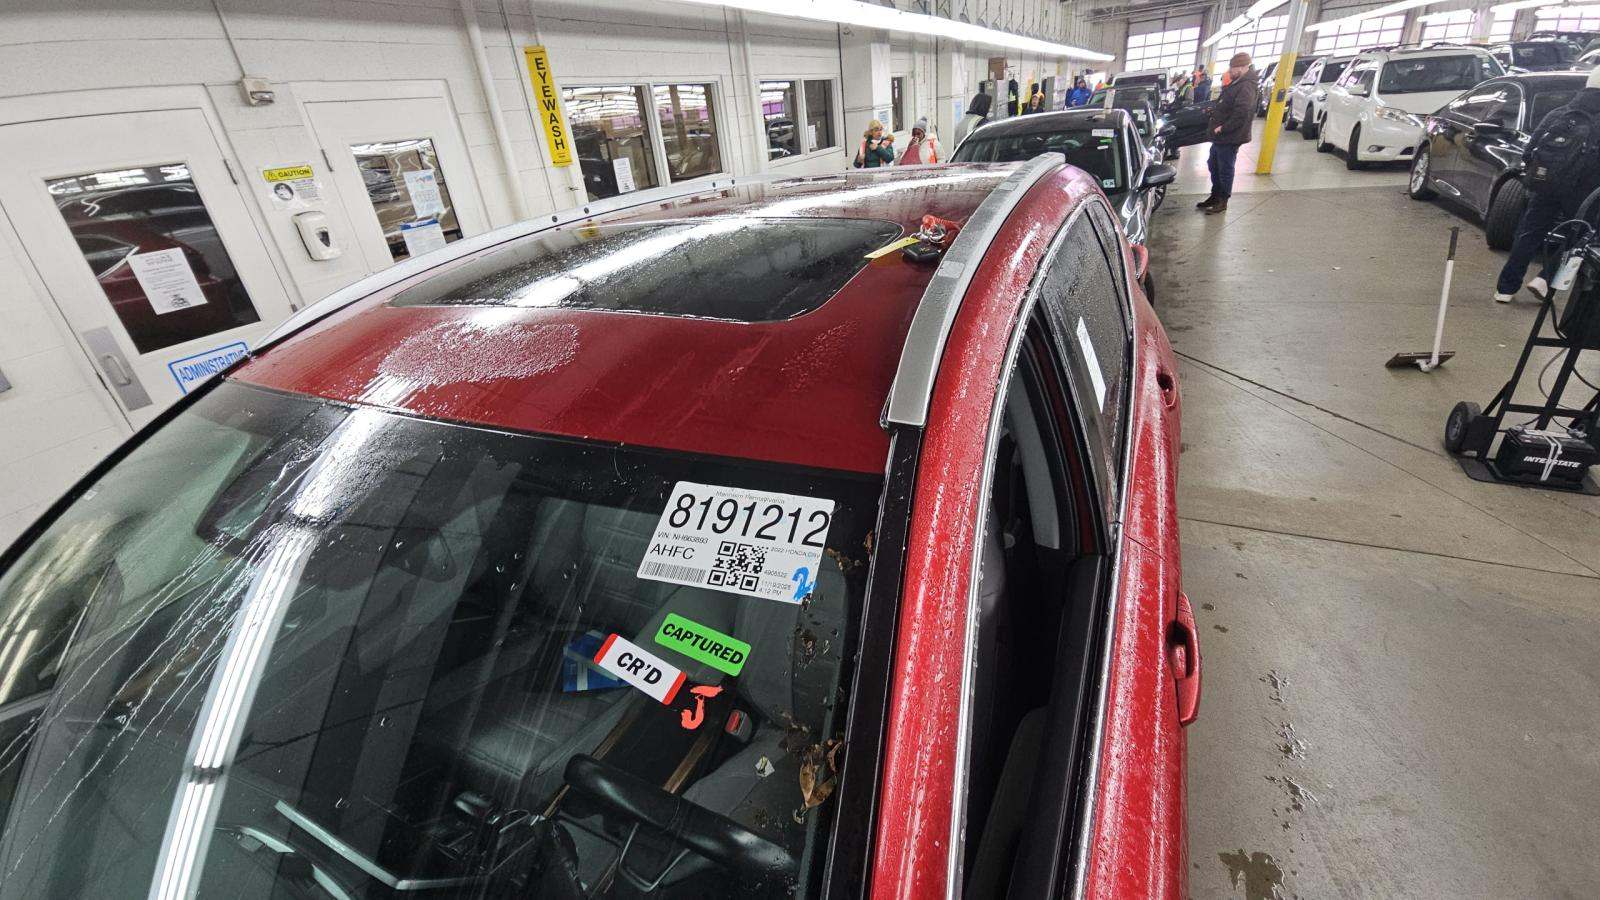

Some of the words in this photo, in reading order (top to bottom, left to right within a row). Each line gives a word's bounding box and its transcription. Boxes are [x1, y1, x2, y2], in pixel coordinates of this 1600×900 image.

[535, 57, 565, 150] EYEWASH
[278, 169, 310, 178] CAUTION
[669, 493, 830, 548] 8191212
[650, 543, 695, 560] AHFC
[791, 567, 817, 602] 2
[662, 623, 744, 665] CAPTURED
[617, 652, 663, 685] CR'D
